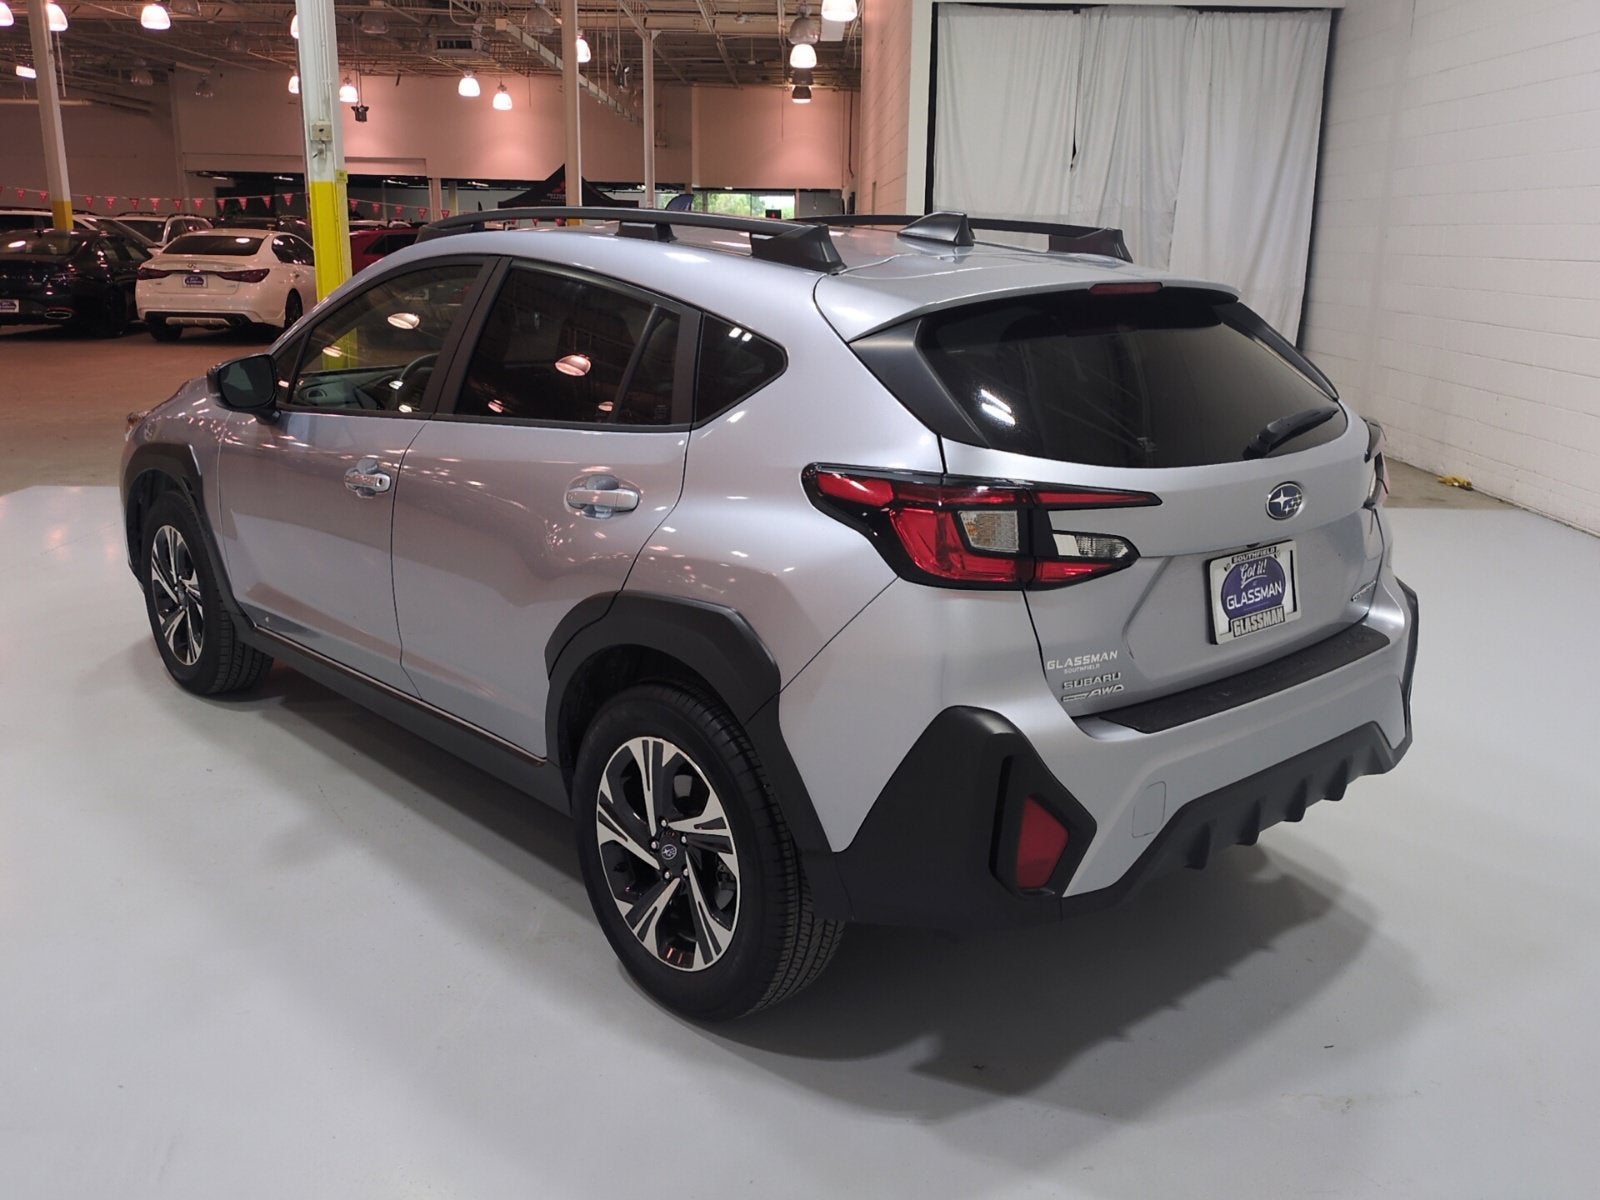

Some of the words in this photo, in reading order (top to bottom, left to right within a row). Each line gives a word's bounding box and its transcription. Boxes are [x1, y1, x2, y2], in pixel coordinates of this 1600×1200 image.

[1240, 562, 1257, 581] Got
[1256, 559, 1267, 575] it!
[1227, 581, 1282, 610] GLASSMAN
[1233, 607, 1284, 637] GLASSMAN
[1046, 650, 1118, 670] GLASSMAN
[1064, 663, 1100, 675] SOUTHFIELD
[1062, 672, 1121, 690] SUBARU
